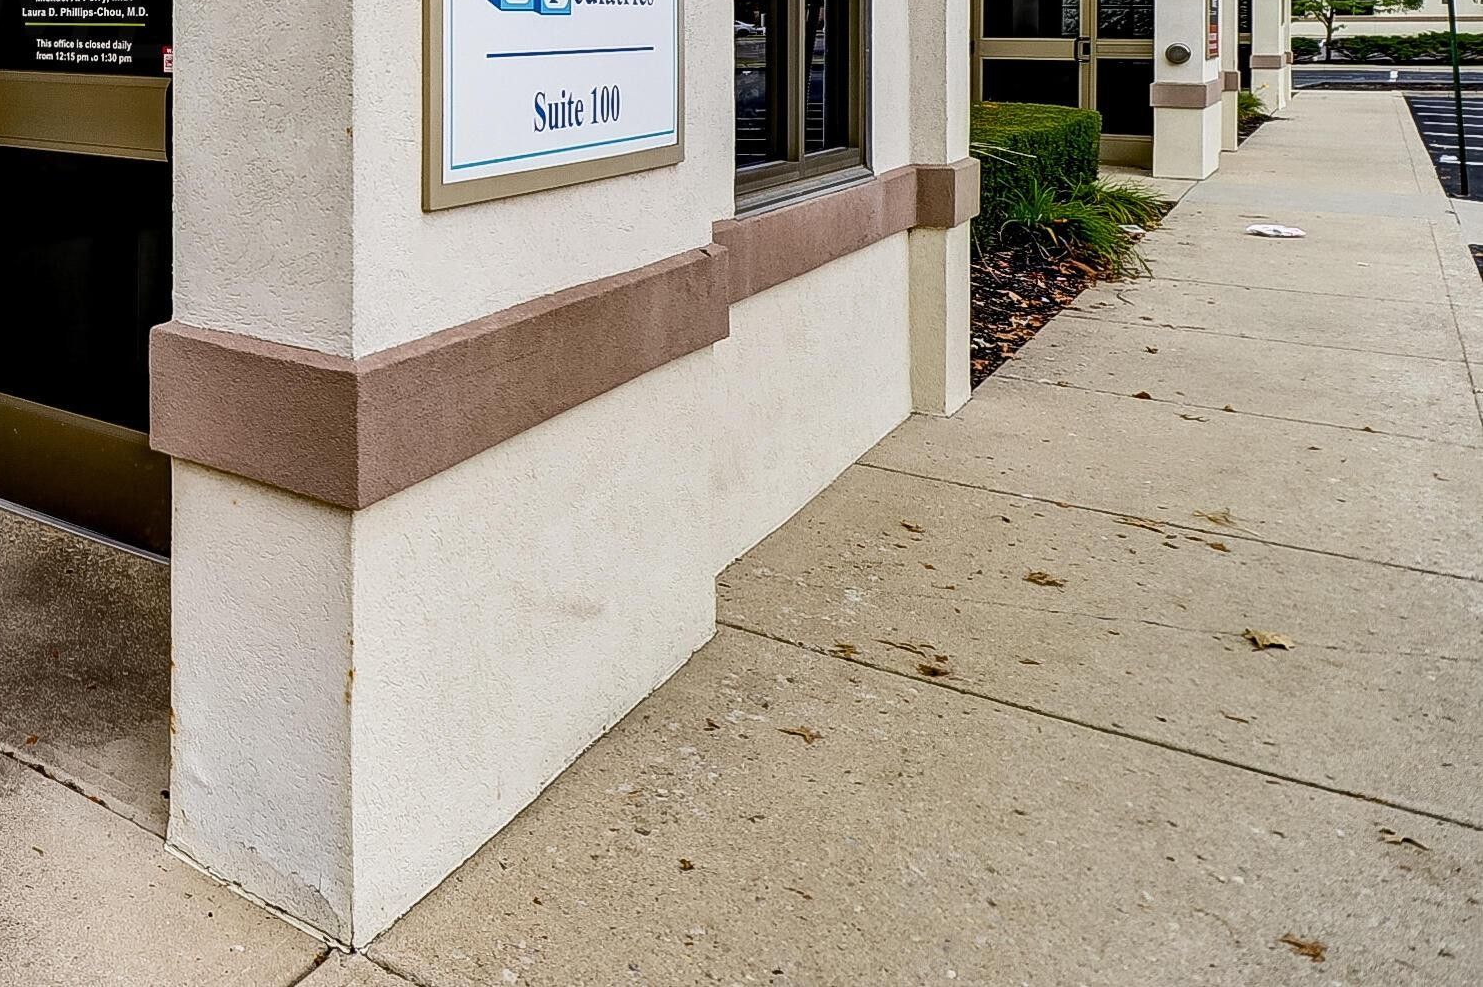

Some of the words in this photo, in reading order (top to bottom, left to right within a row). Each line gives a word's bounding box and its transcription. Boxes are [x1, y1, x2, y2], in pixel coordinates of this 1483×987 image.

[21, 7, 46, 17] Laura
[48, 7, 58, 17] D.
[60, 7, 125, 19] Phillips-Chou,
[126, 6, 149, 17] M.D.
[36, 38, 52, 49] This
[53, 38, 75, 49] office
[76, 39, 83, 49] is
[84, 39, 111, 50] closed
[112, 40, 133, 52] daily
[35, 51, 54, 61] from
[55, 51, 76, 61] 12:15
[77, 54, 89, 63] pm
[100, 52, 117, 63] 1:30
[118, 55, 133, 65] pm
[533, 90, 584, 133] Suite
[590, 84, 620, 125] 100
